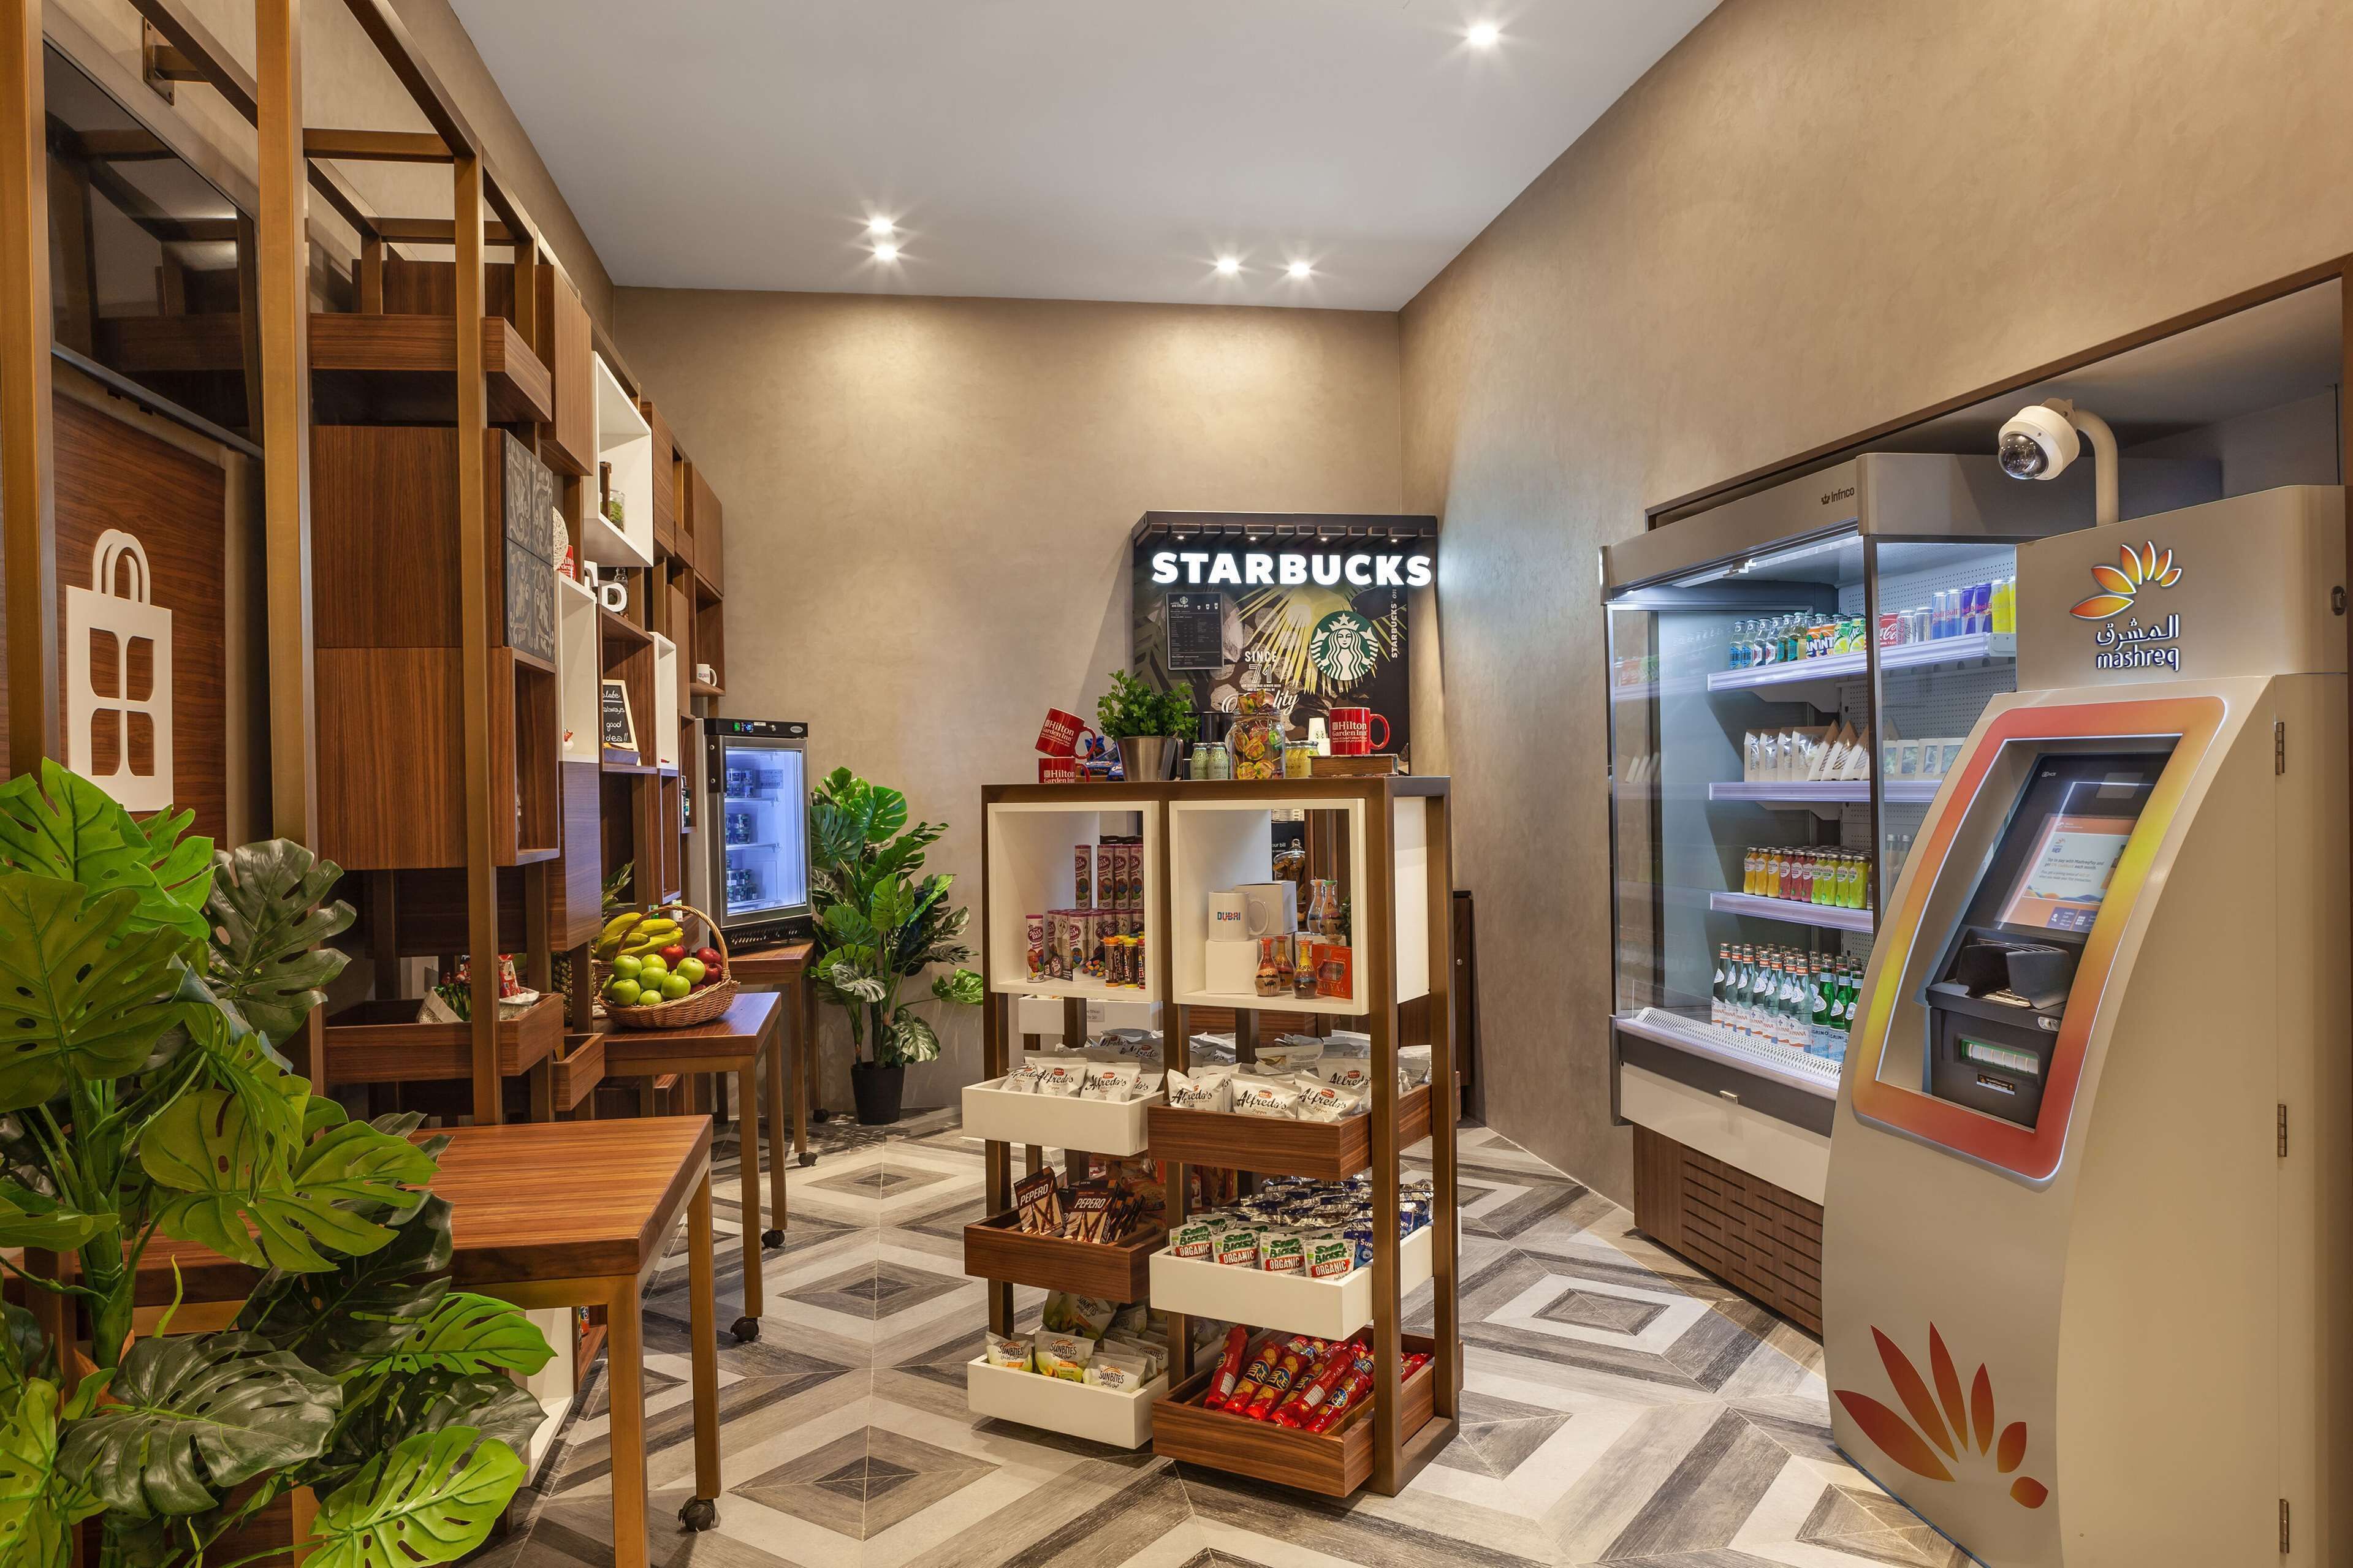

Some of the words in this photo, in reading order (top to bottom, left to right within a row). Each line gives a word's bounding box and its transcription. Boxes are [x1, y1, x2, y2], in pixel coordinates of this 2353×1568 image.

[1831, 487, 1855, 502] Infrico
[1152, 552, 1432, 586] STARBUCKS
[2096, 613, 2180, 652] المشرق
[1245, 651, 1277, 662] SINCE
[2097, 645, 2180, 672] mashreq
[1249, 664, 1272, 683] 71
[1222, 689, 1299, 716] Qlity
[606, 721, 622, 732] good
[1049, 720, 1074, 737] Hilton
[1339, 721, 1367, 730] Hilton
[1043, 727, 1061, 738] Garden
[1062, 733, 1072, 741] Inn
[1051, 770, 1075, 778] Hilton
[1217, 912, 1241, 921] DUBAI
[1318, 983, 1346, 993] ROYAL
[1085, 1075, 1127, 1090] Alfredo's
[1171, 1088, 1213, 1104] Alfredo's
[1237, 1090, 1287, 1110] Alfredo's
[1299, 1088, 1347, 1109] Alfredo's
[1021, 1183, 1049, 1206] PEPERO
[1074, 1197, 1106, 1209] PEPERO
[1180, 1225, 1209, 1236] Sun
[1223, 1233, 1253, 1242] Sun
[1180, 1244, 1209, 1256] ORGANIC
[1223, 1238, 1256, 1252] Blast
[1270, 1238, 1300, 1248] Sun
[1315, 1243, 1344, 1254] Sun
[1223, 1250, 1255, 1263] ORGANIC
[1269, 1244, 1303, 1258] Blast
[1315, 1248, 1347, 1265] Blast
[1269, 1257, 1300, 1270] ORGANIC
[1315, 1261, 1347, 1276] ORGANIC
[1077, 1295, 1098, 1317] SUNBITES
[998, 1344, 1024, 1356] SUNBITES
[1049, 1343, 1078, 1355] SUNBITES
[1099, 1370, 1125, 1384] SUNBITES
